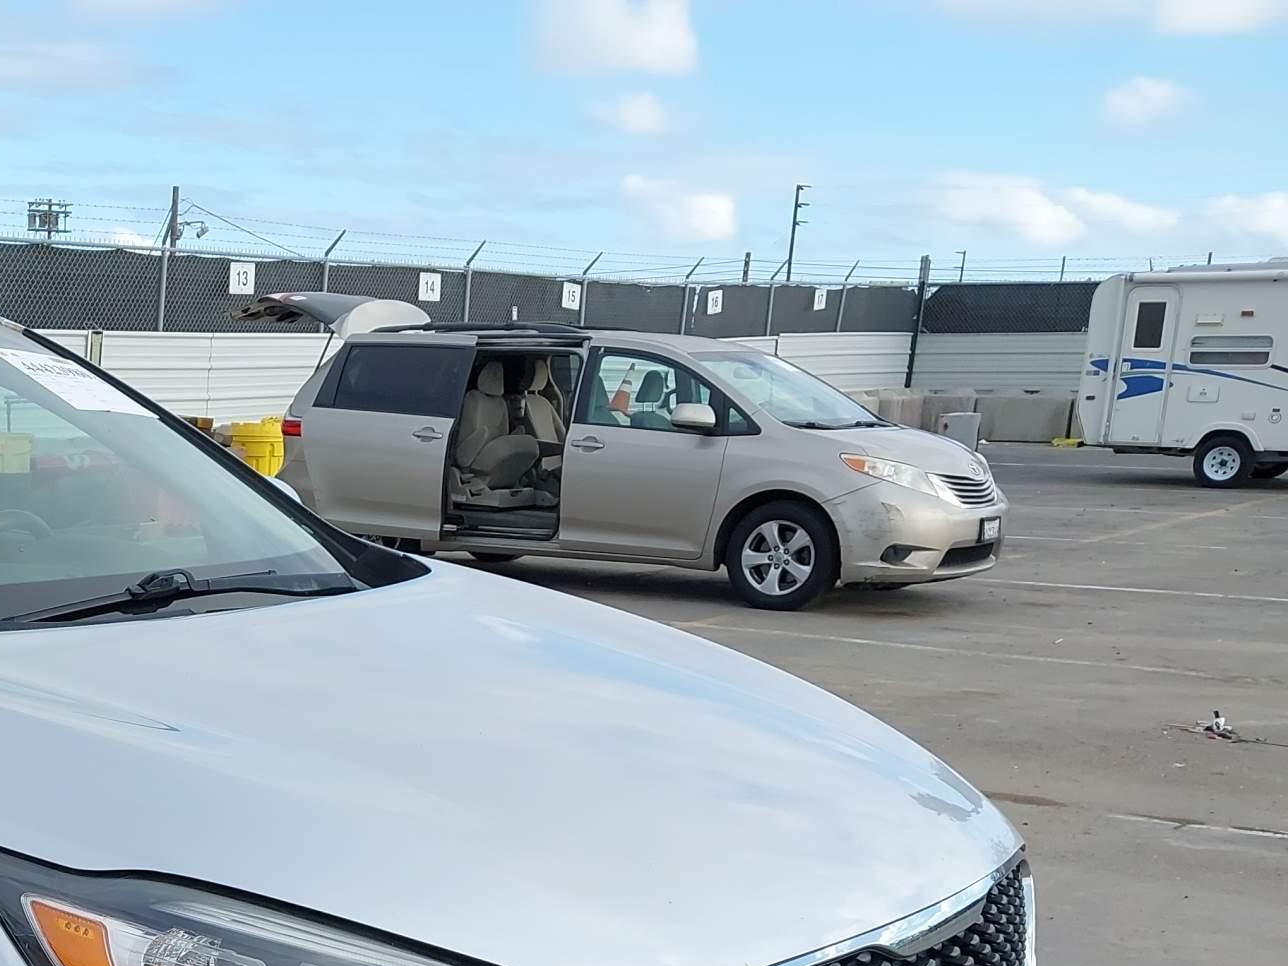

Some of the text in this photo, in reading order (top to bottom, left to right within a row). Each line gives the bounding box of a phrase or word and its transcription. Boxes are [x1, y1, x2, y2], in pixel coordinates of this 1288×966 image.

[236, 269, 249, 287] 13
[424, 279, 435, 294] 14
[567, 289, 576, 303] 15
